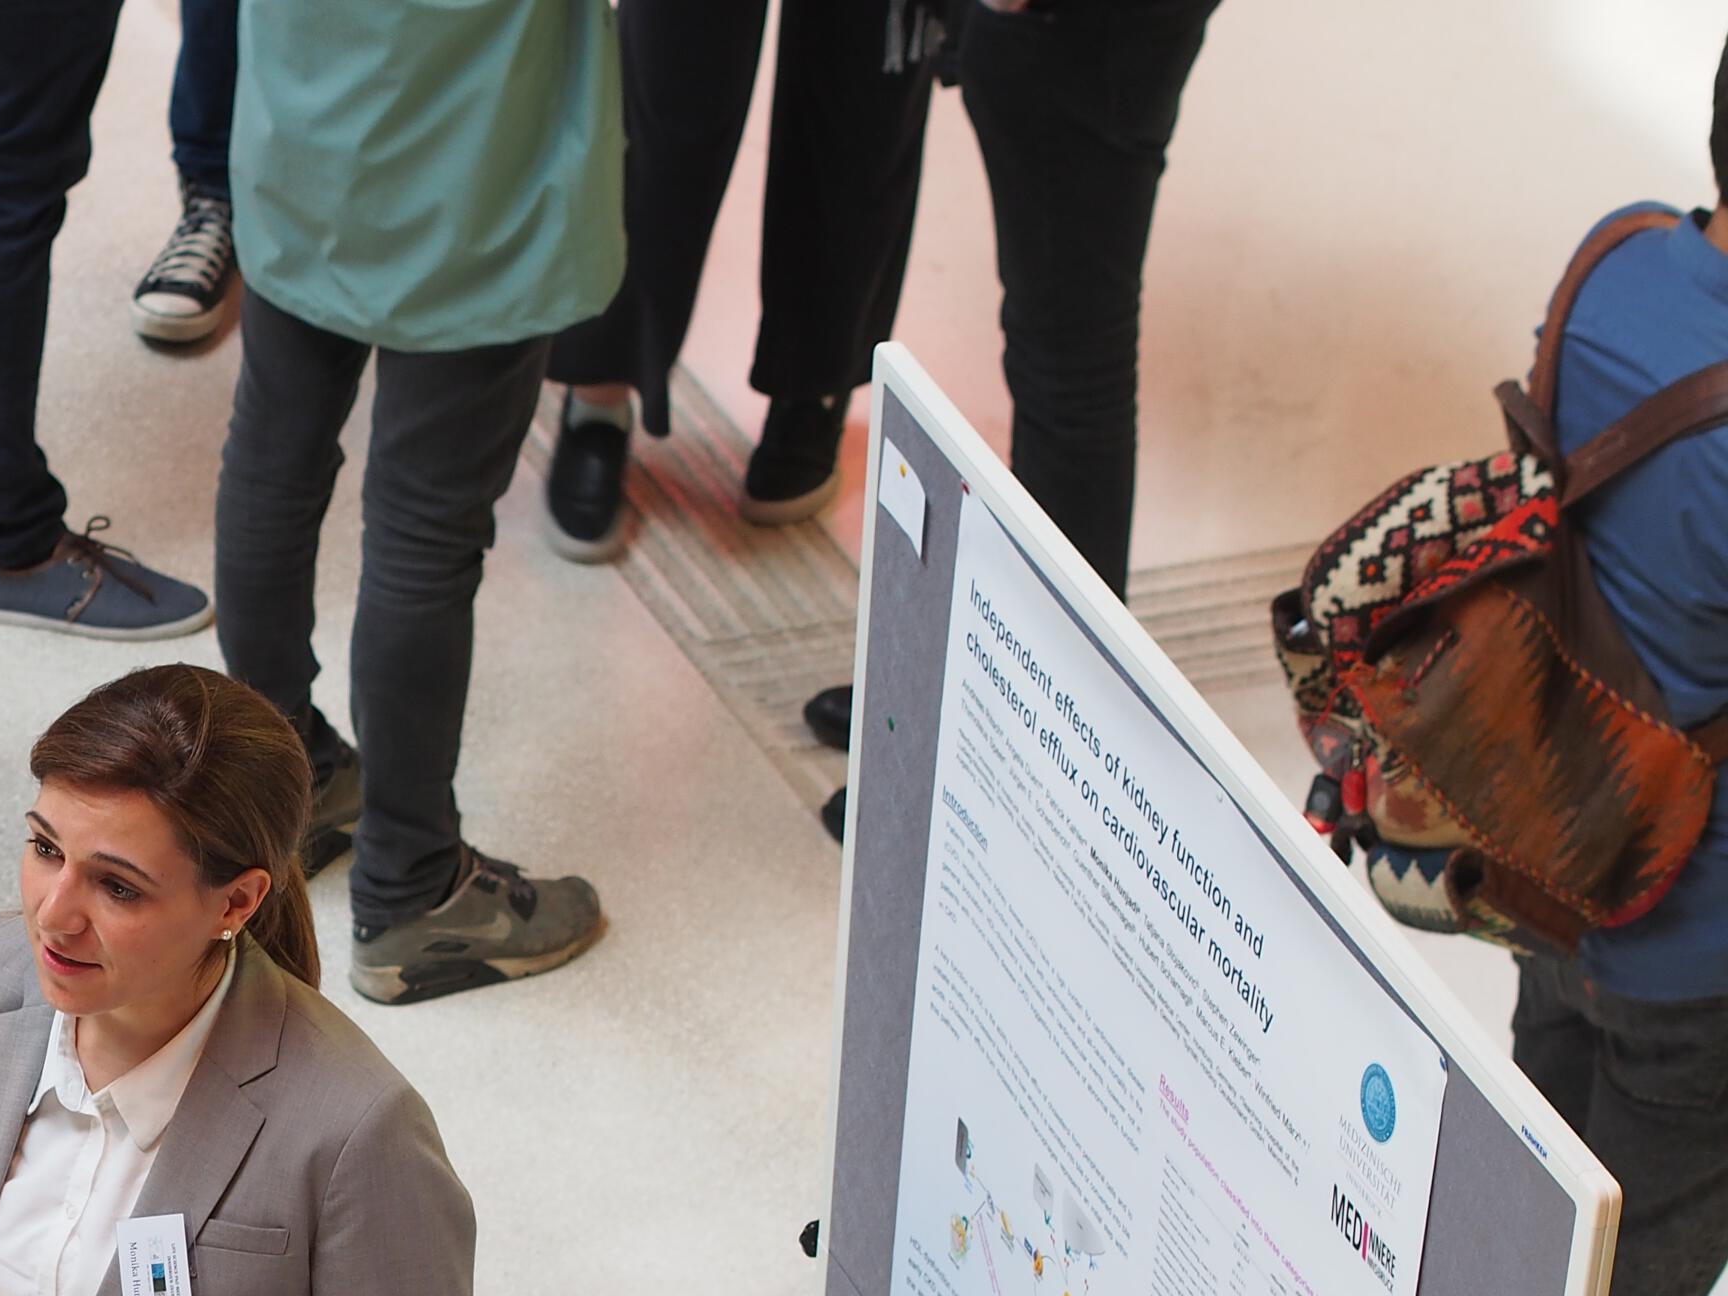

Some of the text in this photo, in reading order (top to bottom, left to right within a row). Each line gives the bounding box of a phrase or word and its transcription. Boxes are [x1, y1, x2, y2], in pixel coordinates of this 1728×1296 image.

[970, 580, 1052, 699] Independent
[1055, 691, 1101, 758] effects
[1104, 753, 1121, 779] of
[1122, 767, 1169, 845] kidney
[1171, 829, 1231, 920] function
[1234, 913, 1264, 959] and
[942, 785, 988, 853] Introduction
[966, 632, 1037, 734] cholesterol
[1039, 728, 1078, 786] efflux
[1081, 780, 1099, 812] on
[1102, 806, 1205, 943] cardiovascular
[1208, 939, 1273, 1033] mortality
[1089, 846, 1114, 884] Monika
[1158, 1073, 1191, 1125] Results
[1158, 1097, 1171, 1120] The
[1169, 1112, 1188, 1144] study
[1187, 1134, 1221, 1185] population
[1220, 1175, 1251, 1222] classified
[1263, 1230, 1281, 1259] three
[1339, 1114, 1401, 1195] MEDIZINISCHE
[128, 1242, 140, 1277] Monika
